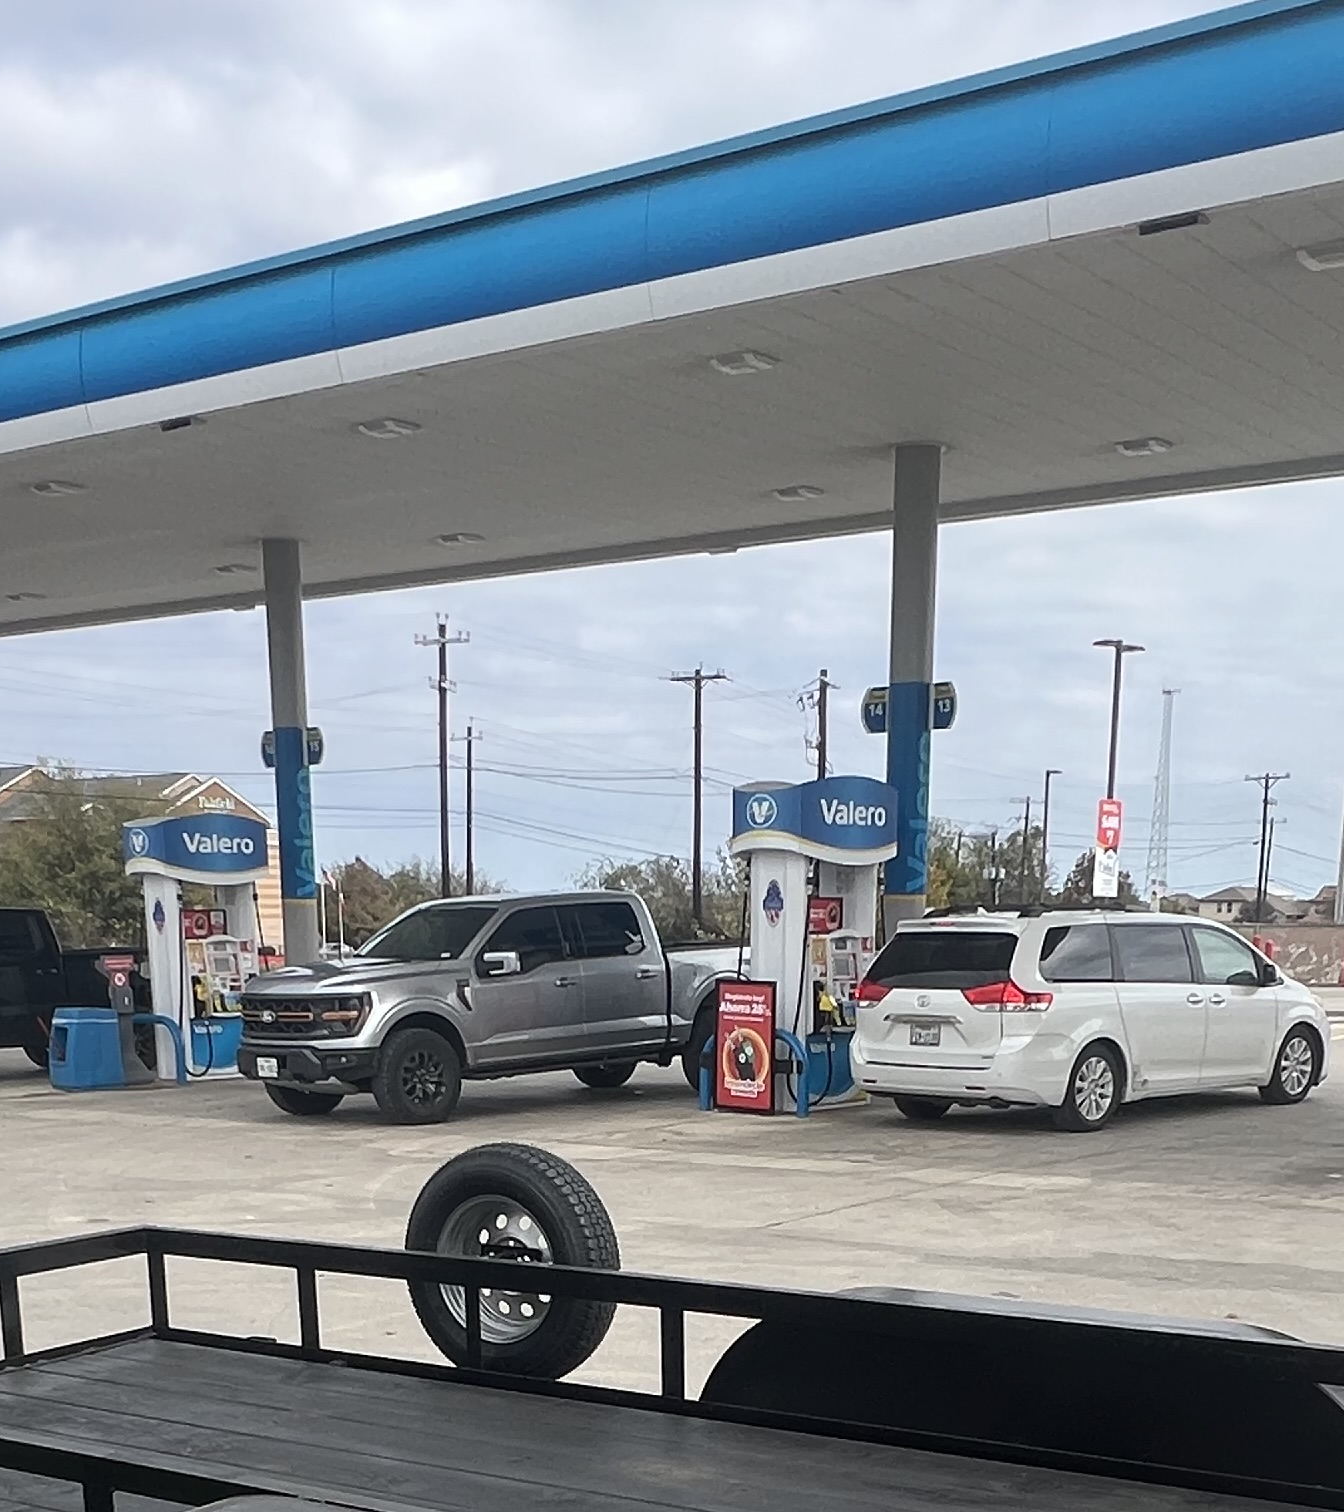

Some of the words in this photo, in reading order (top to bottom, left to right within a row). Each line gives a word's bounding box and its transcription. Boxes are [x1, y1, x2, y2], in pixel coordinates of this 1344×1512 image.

[868, 704, 883, 717] 14
[937, 700, 951, 713] 13
[820, 798, 887, 828] Valero
[182, 832, 254, 855] Valero
